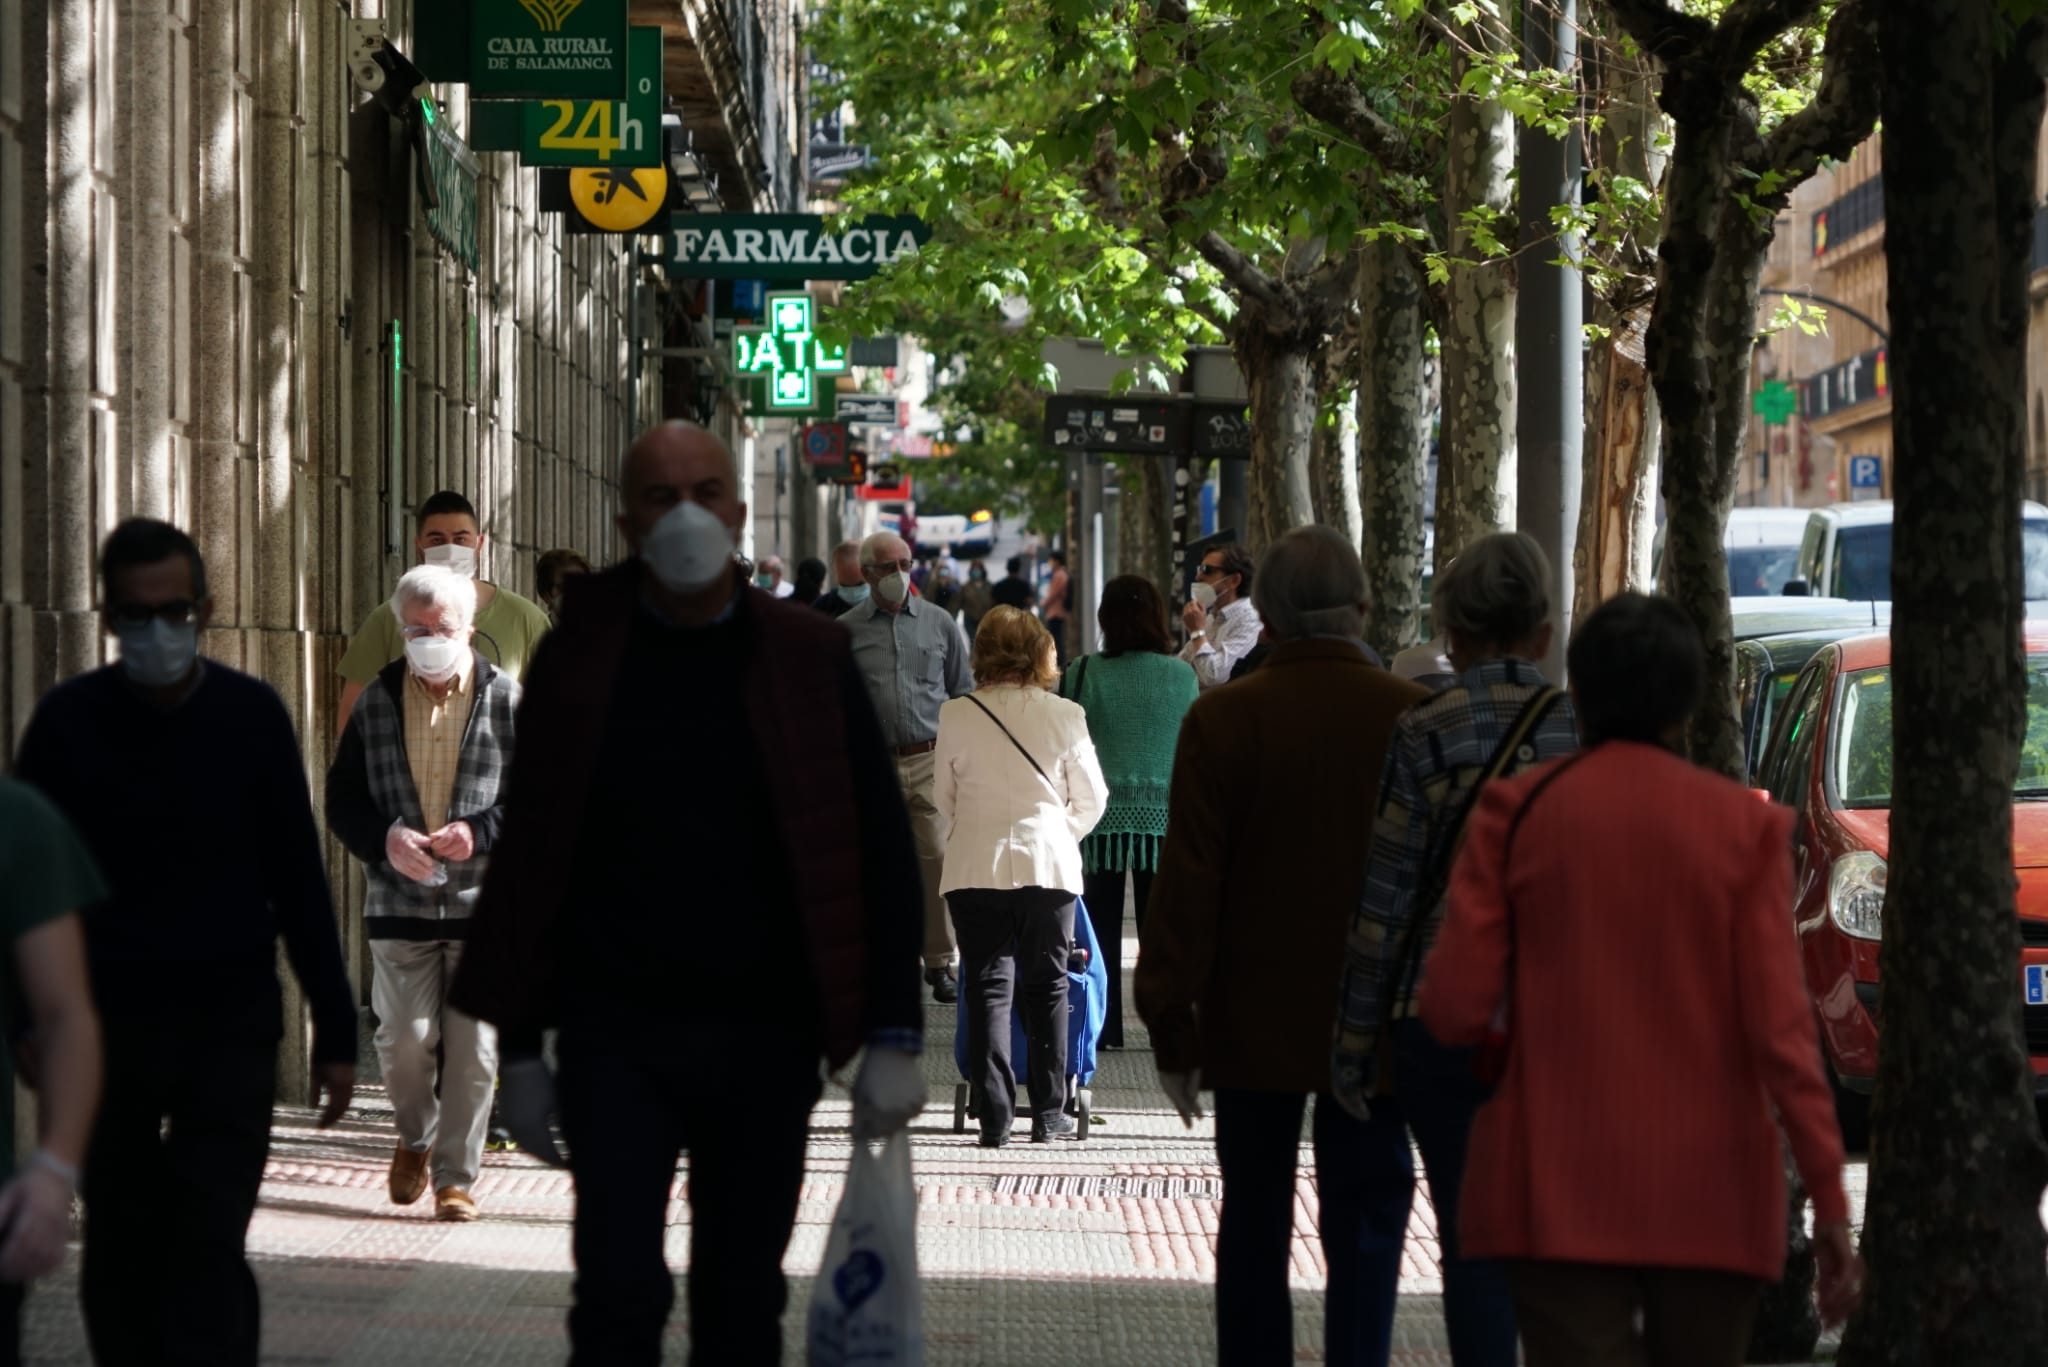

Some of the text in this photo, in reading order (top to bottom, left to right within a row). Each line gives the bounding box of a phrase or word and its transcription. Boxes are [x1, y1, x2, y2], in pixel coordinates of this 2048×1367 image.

[487, 37, 613, 56] CAJA RURAL
[487, 56, 613, 70] DE SALAMANCA
[539, 99, 643, 160] 24h
[673, 228, 919, 264] FARMACIA
[1856, 458, 1876, 484] P
